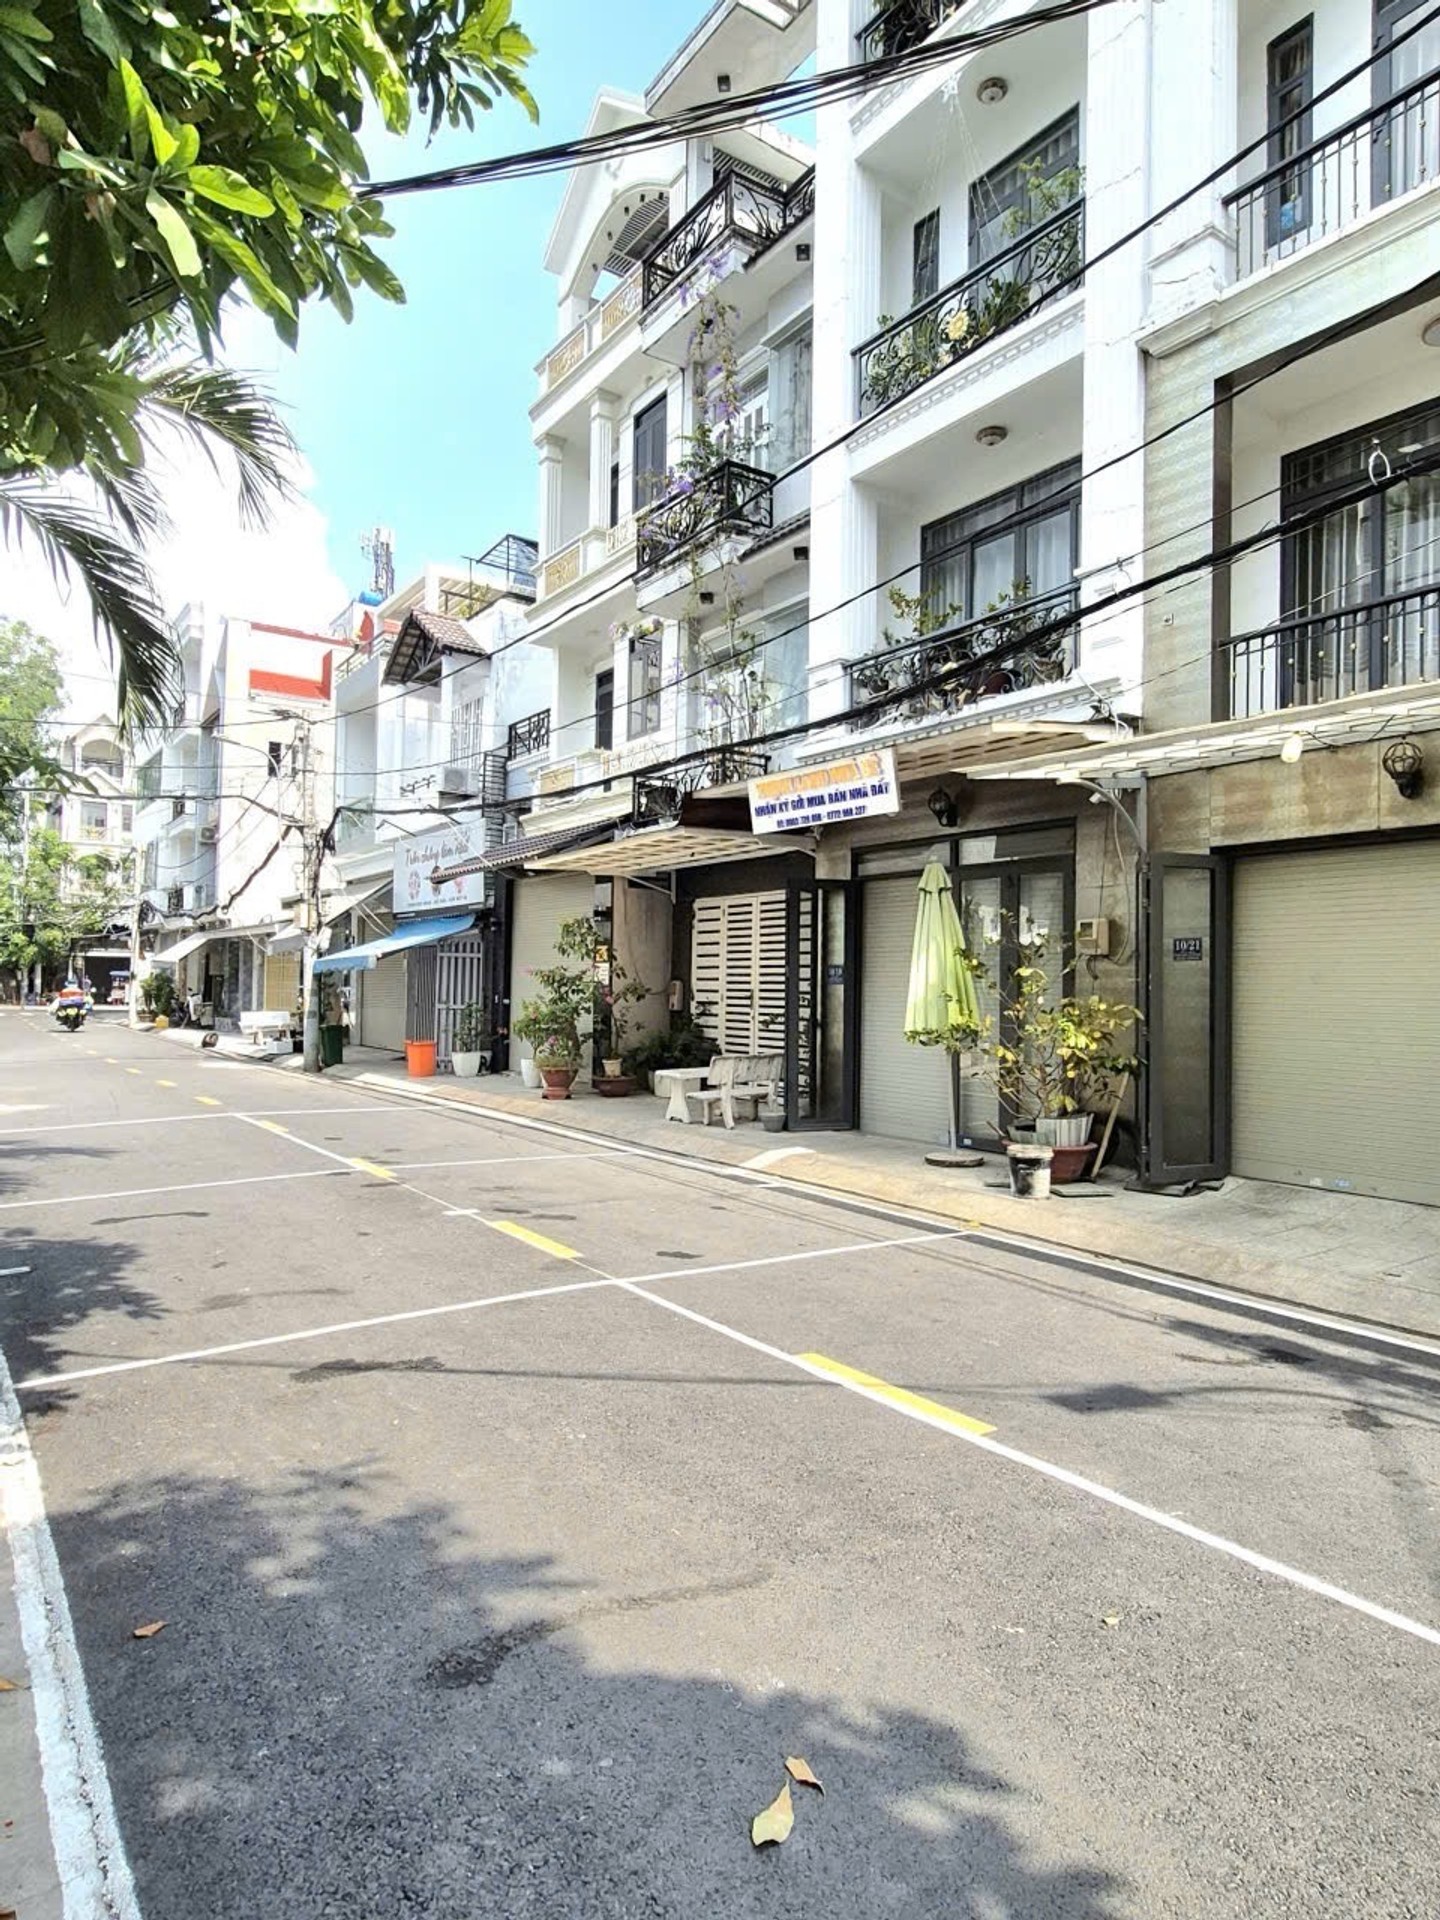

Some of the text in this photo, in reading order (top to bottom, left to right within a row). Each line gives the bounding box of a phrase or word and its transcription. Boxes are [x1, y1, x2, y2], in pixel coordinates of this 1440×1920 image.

[754, 802, 777, 818] NHẬN
[806, 794, 825, 808] MUA
[828, 788, 847, 804] BÁN
[849, 783, 868, 800] NHÀ
[870, 777, 889, 796] ĐẤT
[1175, 939, 1200, 951] 10/21
